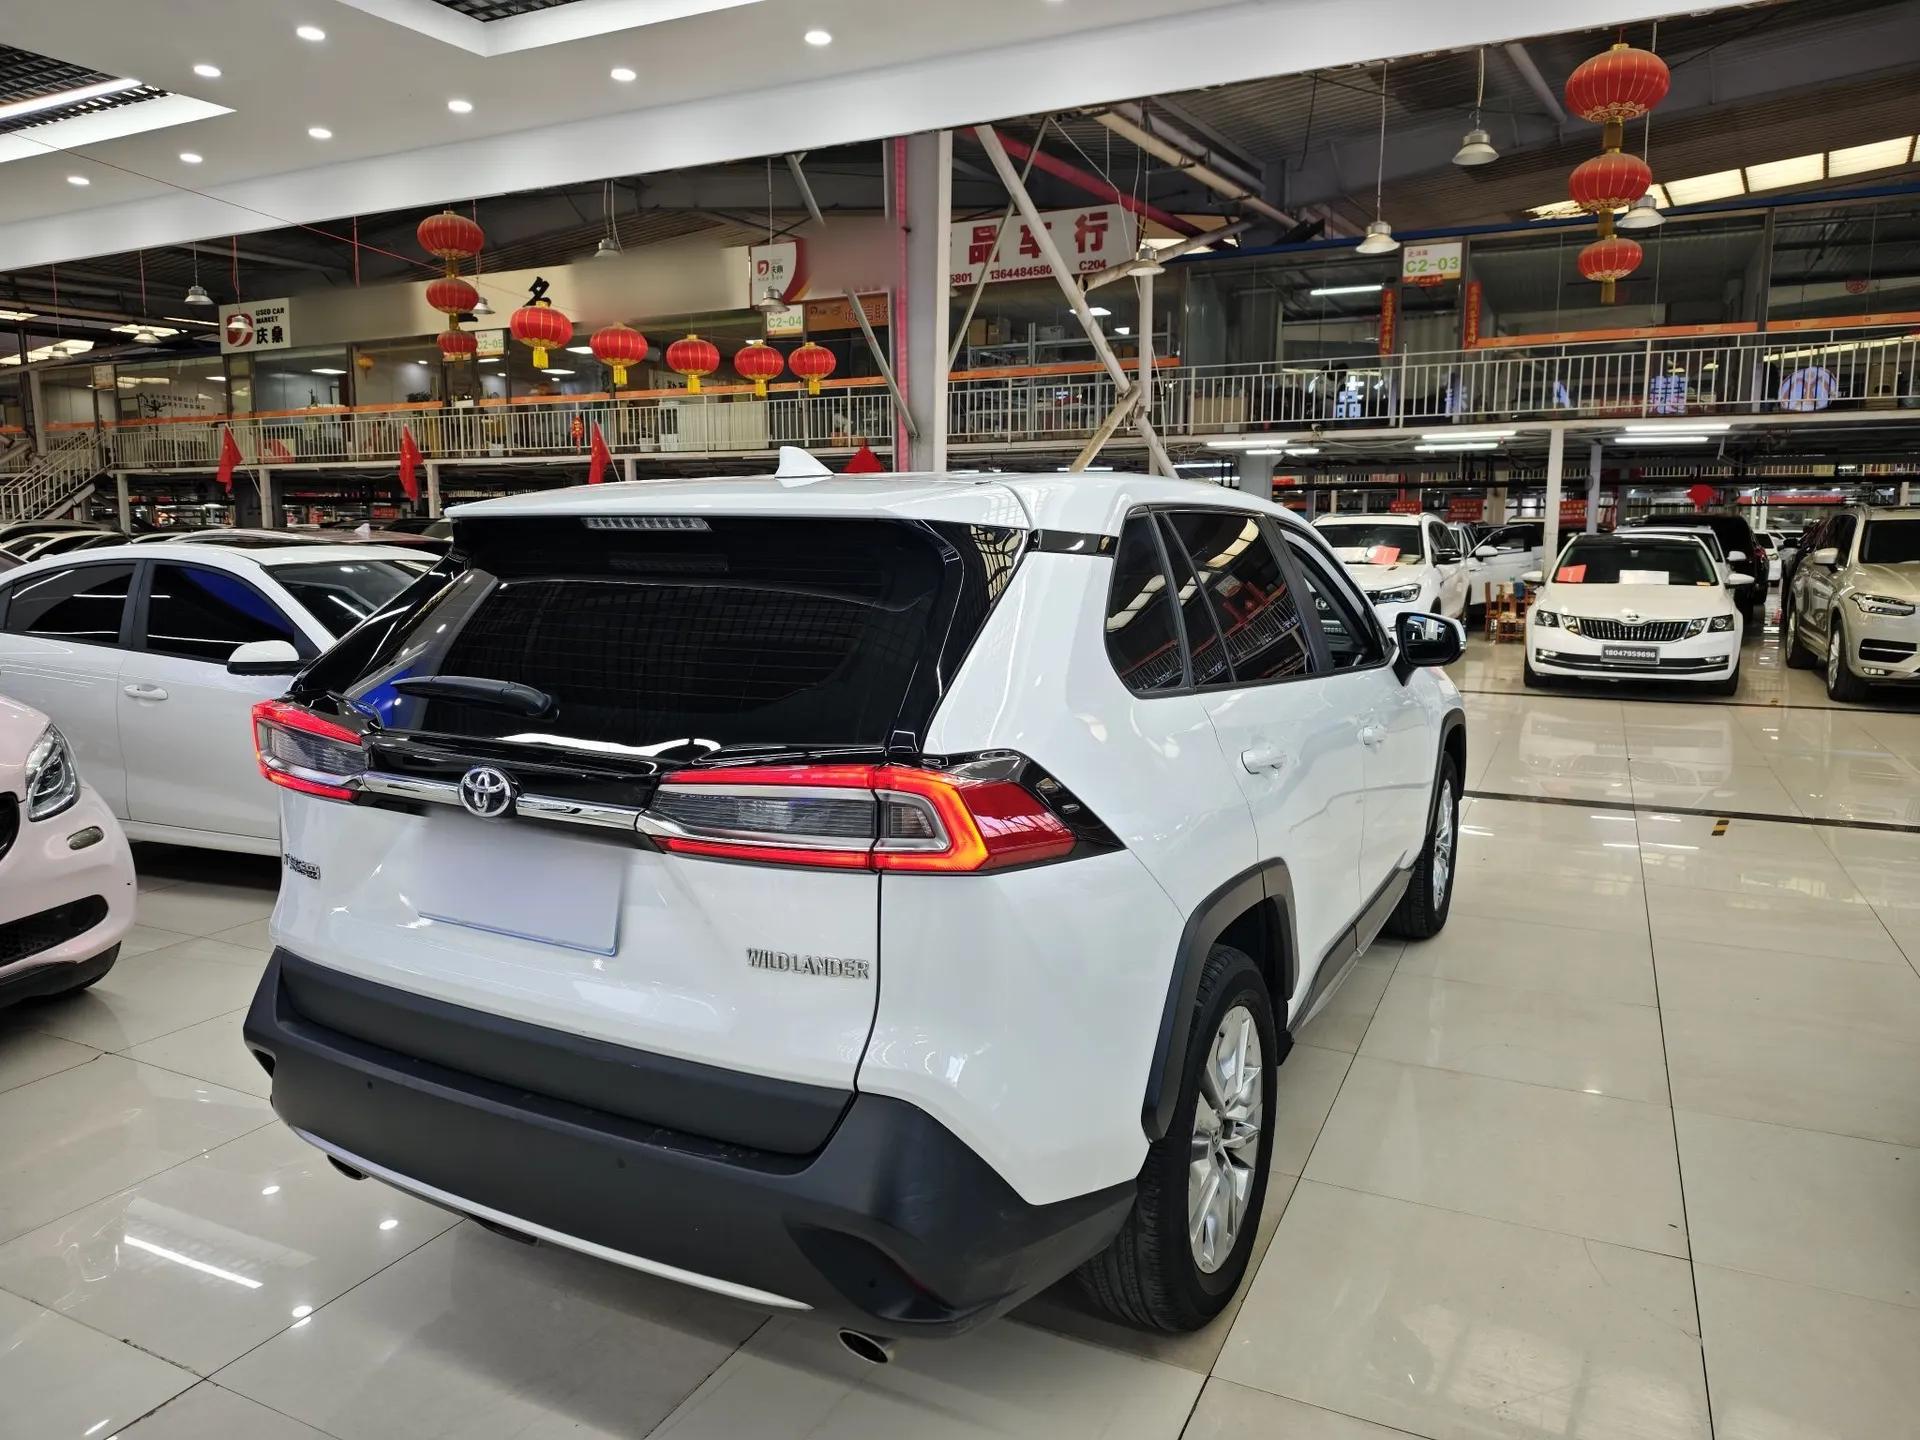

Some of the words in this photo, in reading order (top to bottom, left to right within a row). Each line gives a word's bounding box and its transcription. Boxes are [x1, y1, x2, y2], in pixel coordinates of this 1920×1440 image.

[1079, 259, 1107, 271] C204
[1405, 256, 1459, 273] C2-03
[989, 264, 1053, 281] 1364484580
[255, 308, 271, 316] USED
[272, 307, 285, 315] CAR
[256, 315, 278, 324] MARKET
[746, 947, 870, 980] WILDLANDER
